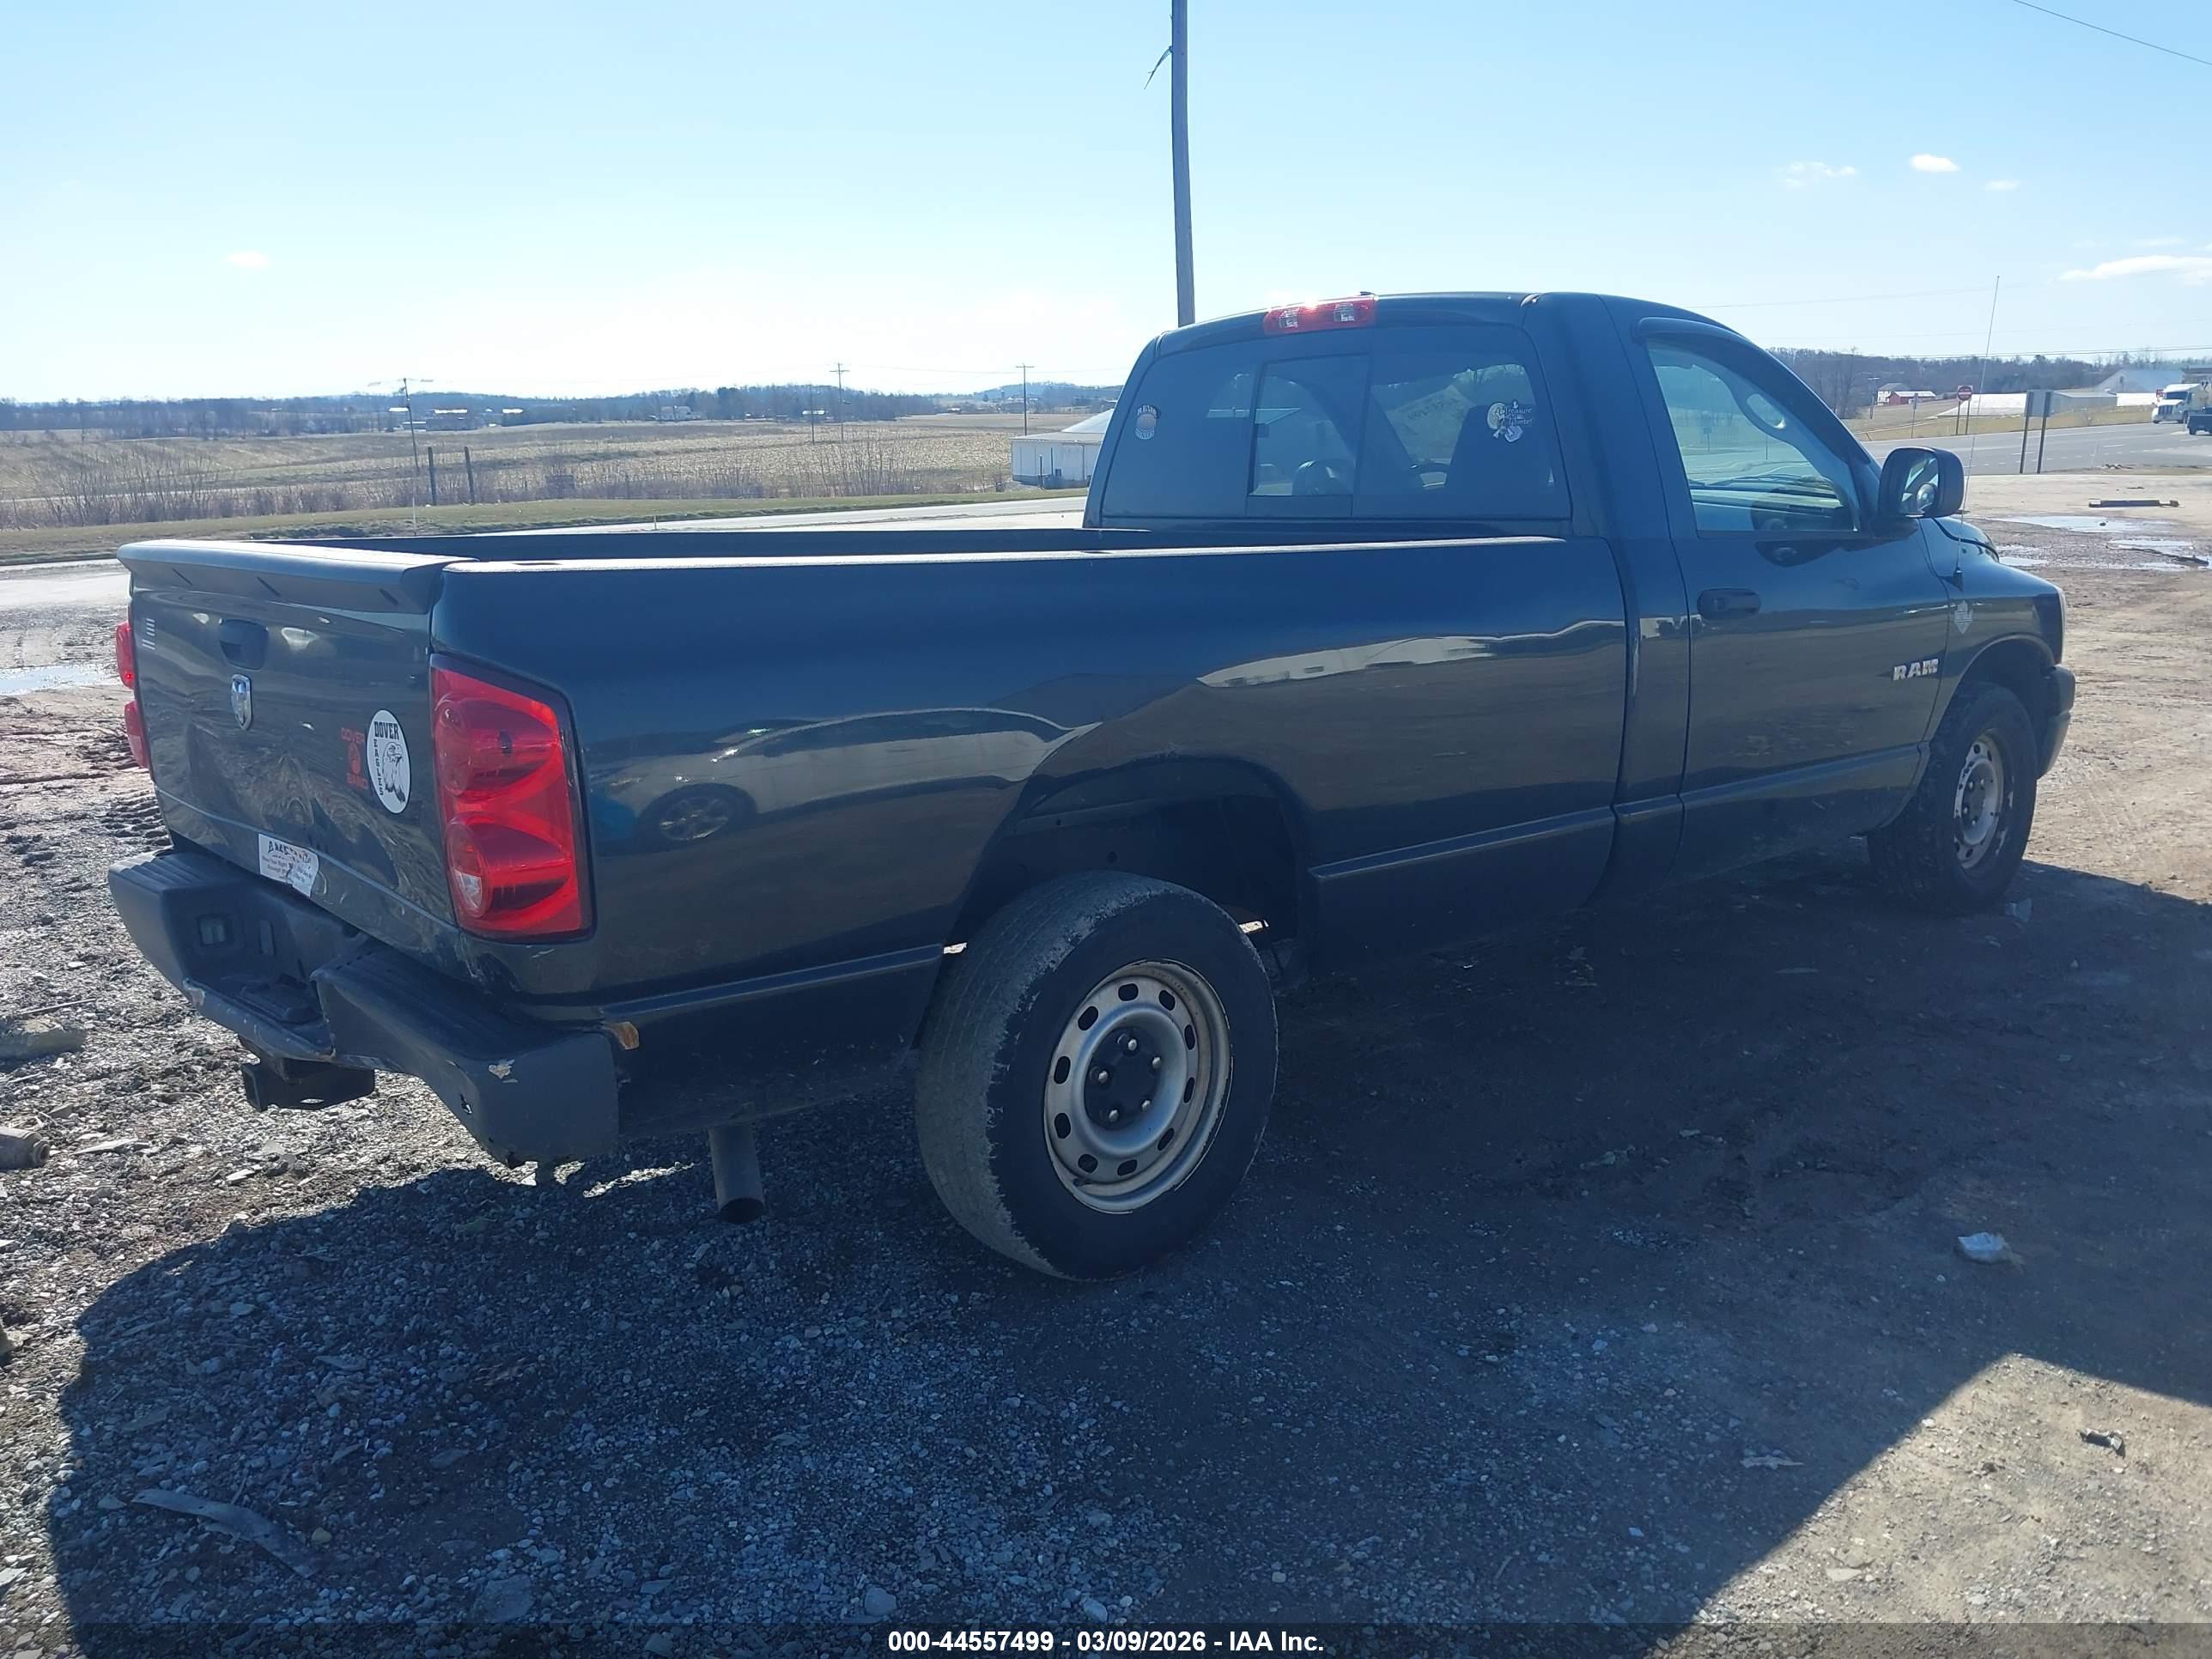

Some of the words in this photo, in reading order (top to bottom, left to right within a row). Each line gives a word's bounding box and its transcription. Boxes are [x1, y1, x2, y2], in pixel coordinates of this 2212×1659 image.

[1893, 658, 1939, 681] RAM
[374, 721, 400, 740] DOVER
[374, 738, 385, 796] EAGLES
